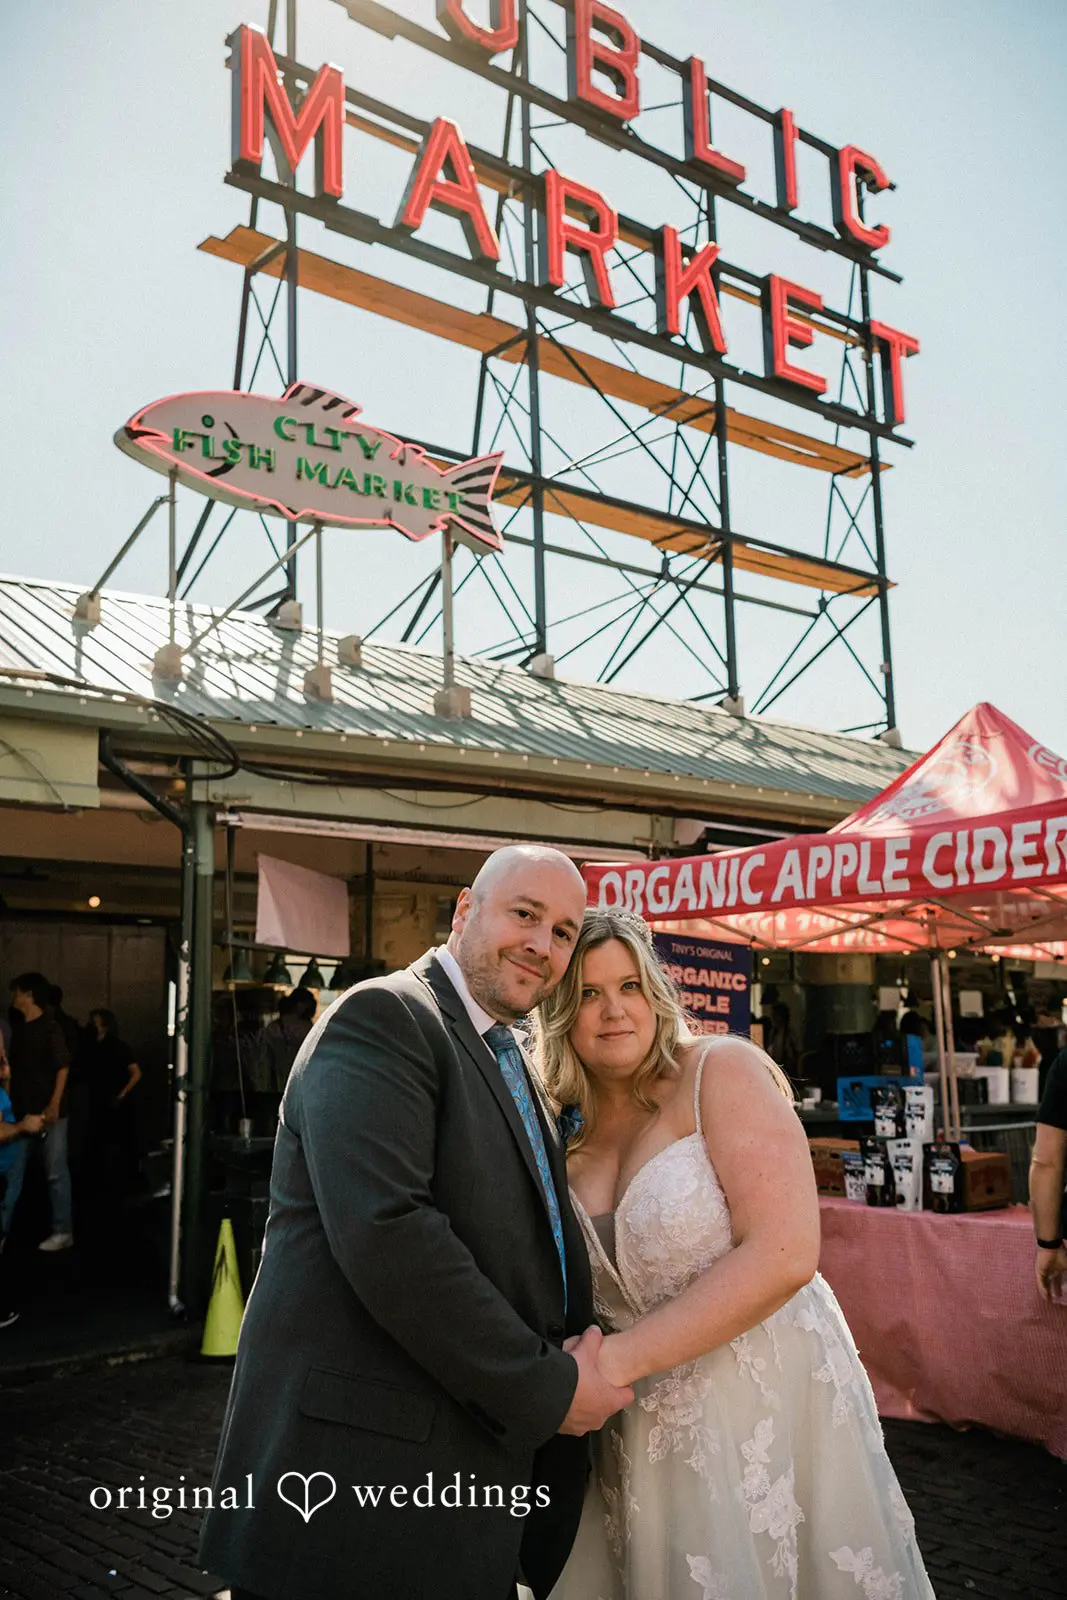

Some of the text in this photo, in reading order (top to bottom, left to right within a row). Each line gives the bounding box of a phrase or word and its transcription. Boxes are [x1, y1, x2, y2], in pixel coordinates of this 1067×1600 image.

[230, 22, 919, 425] MARKET
[273, 415, 383, 461] CITY
[172, 427, 467, 514] FISH MARKET
[598, 852, 766, 915] ORGANIC
[770, 836, 911, 902] APPLE
[696, 946, 734, 962] ORIGINAL
[678, 990, 731, 1015] PPLE
